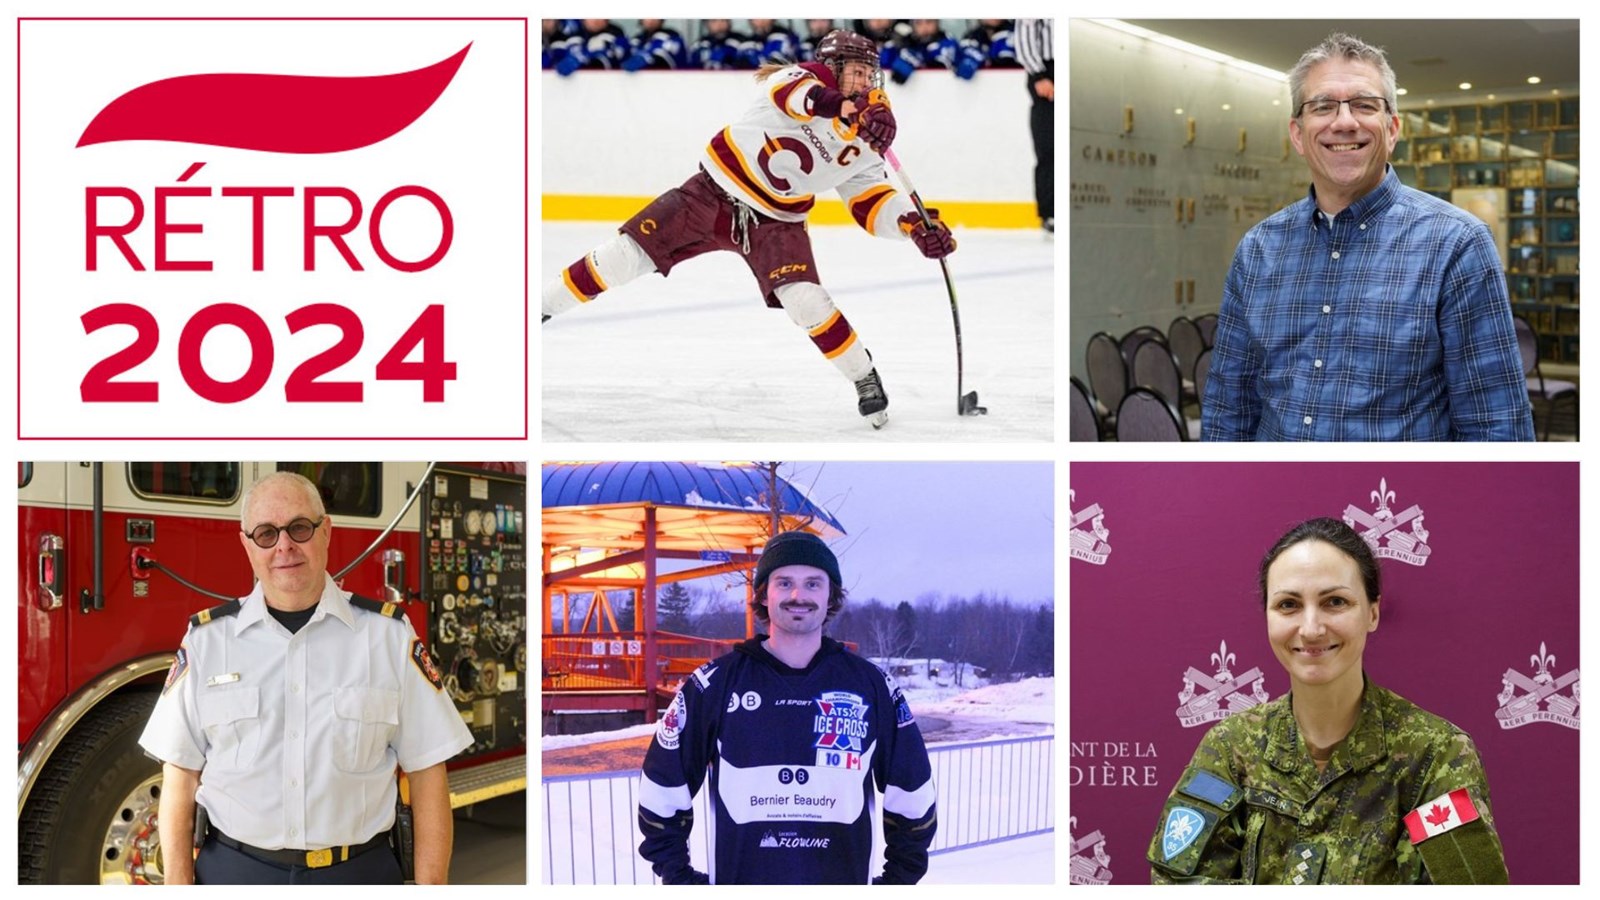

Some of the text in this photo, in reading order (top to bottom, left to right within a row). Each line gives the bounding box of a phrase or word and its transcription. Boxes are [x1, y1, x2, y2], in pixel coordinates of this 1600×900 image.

[837, 145, 860, 166] C
[769, 264, 807, 279] CCM
[1185, 710, 1233, 725] AERE PER
[1503, 716, 1526, 727] AERE
[814, 715, 868, 738] ICE CROSS
[1071, 742, 1158, 757] NT DE LA
[826, 752, 840, 765] 10
[1069, 761, 1158, 786] DIÈRE
[750, 794, 836, 809] Bernier Beaudry
[778, 837, 830, 849] FLOWLINE
